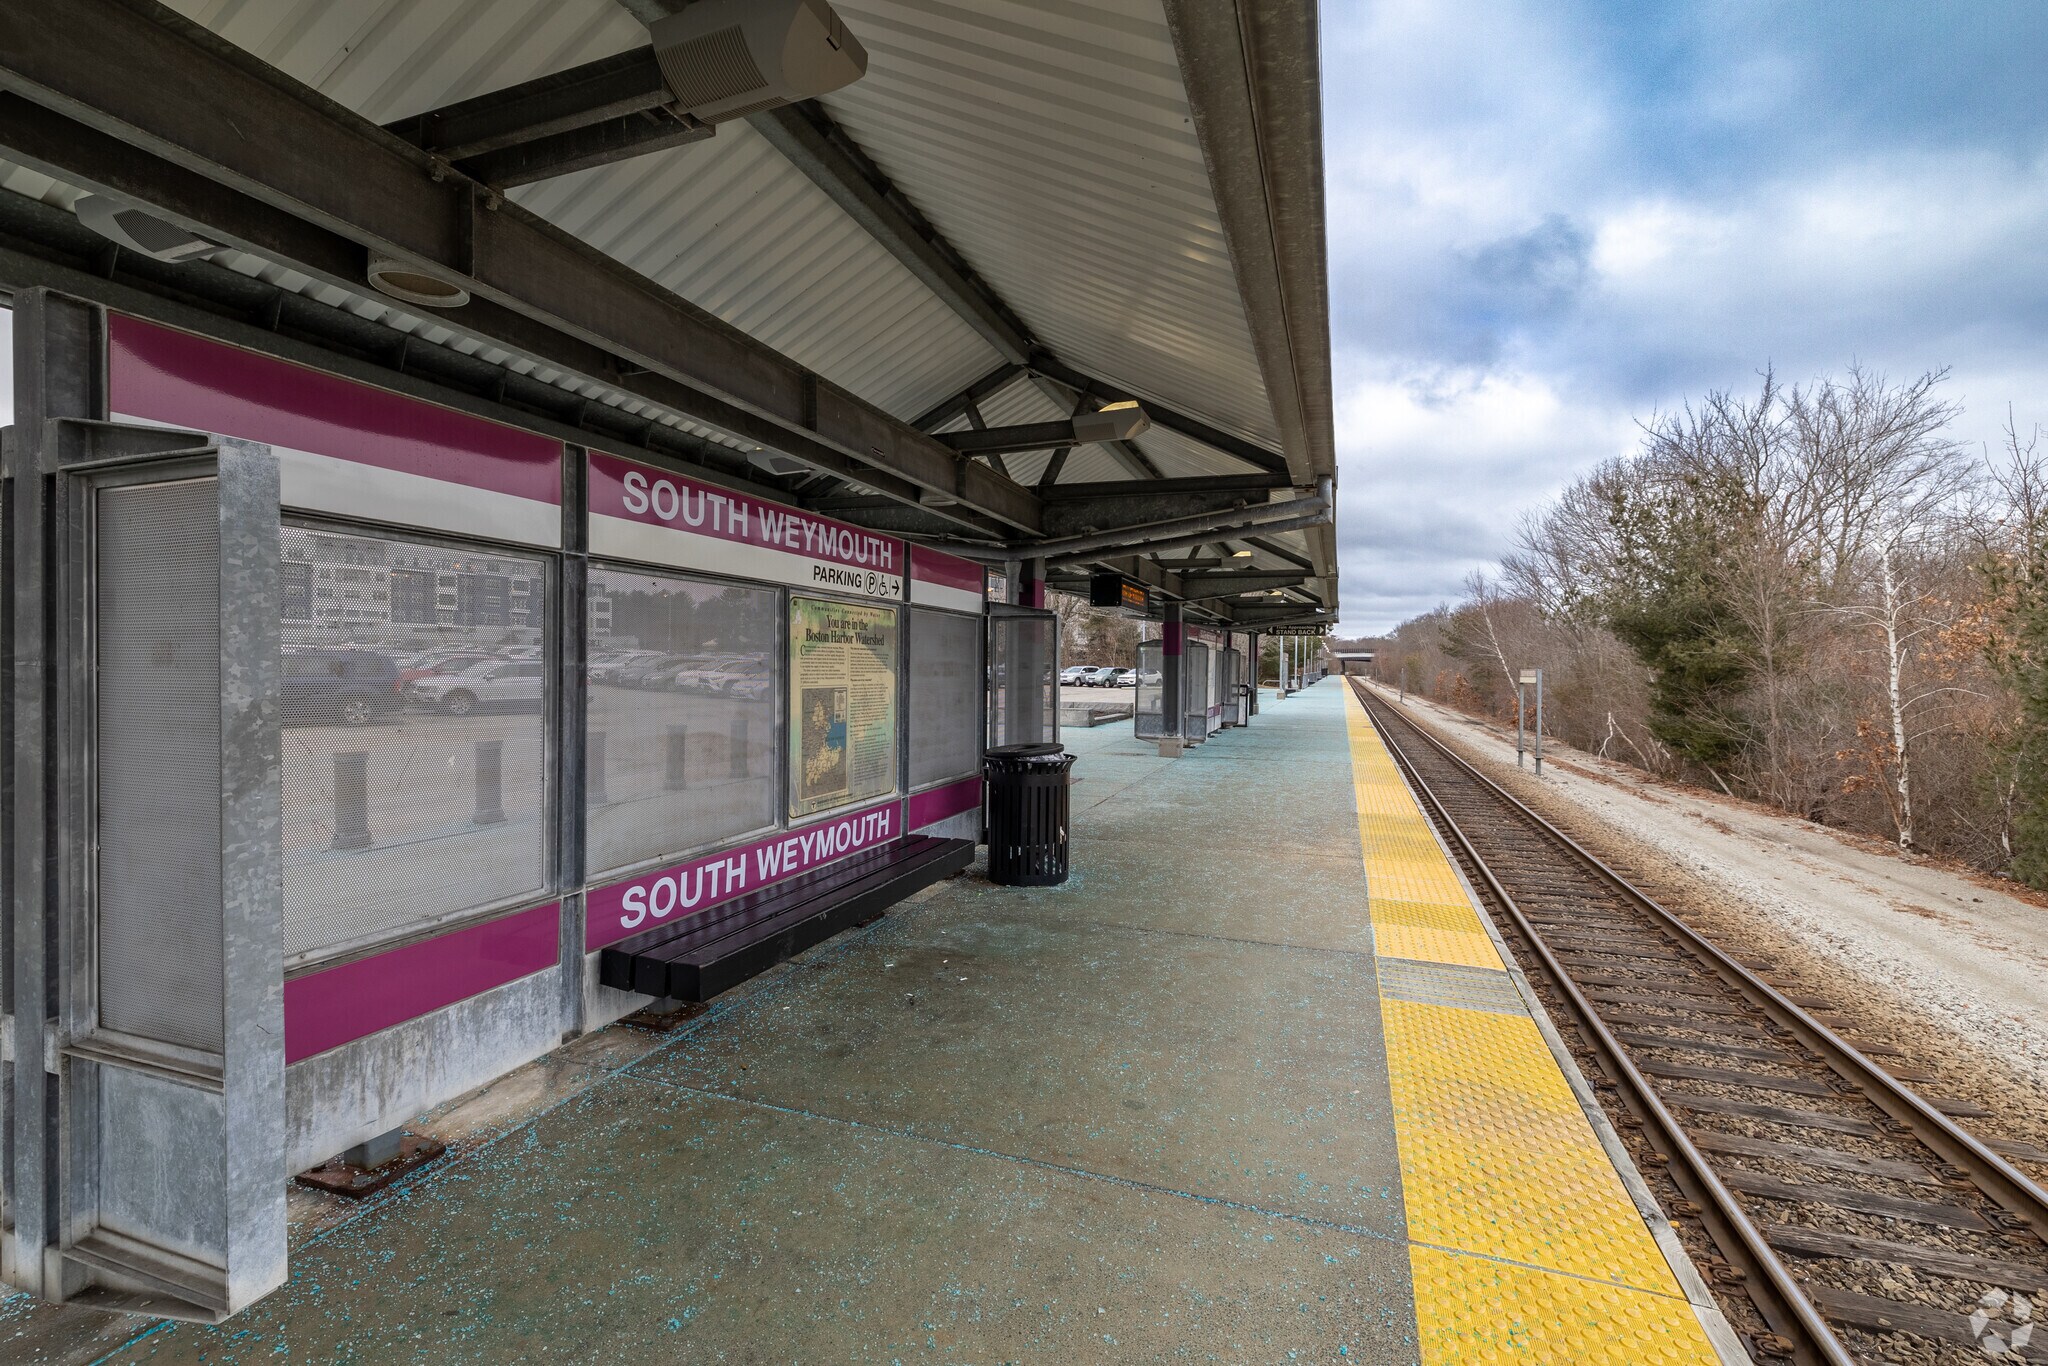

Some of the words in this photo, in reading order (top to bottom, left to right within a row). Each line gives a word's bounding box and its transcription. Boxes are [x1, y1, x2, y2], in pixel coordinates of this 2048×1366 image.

[623, 471, 748, 538] SOUTH
[758, 506, 892, 569] WEYMOUTH
[813, 565, 862, 588] PARKING
[826, 614, 839, 629] You
[840, 619, 851, 630] are
[852, 617, 858, 630] in
[858, 618, 868, 631] the
[806, 628, 829, 642] Boston
[831, 630, 854, 644] Harbor
[855, 632, 884, 646] Watershed
[620, 853, 746, 929] SOUTH
[757, 808, 890, 881] WEYMOUTH
